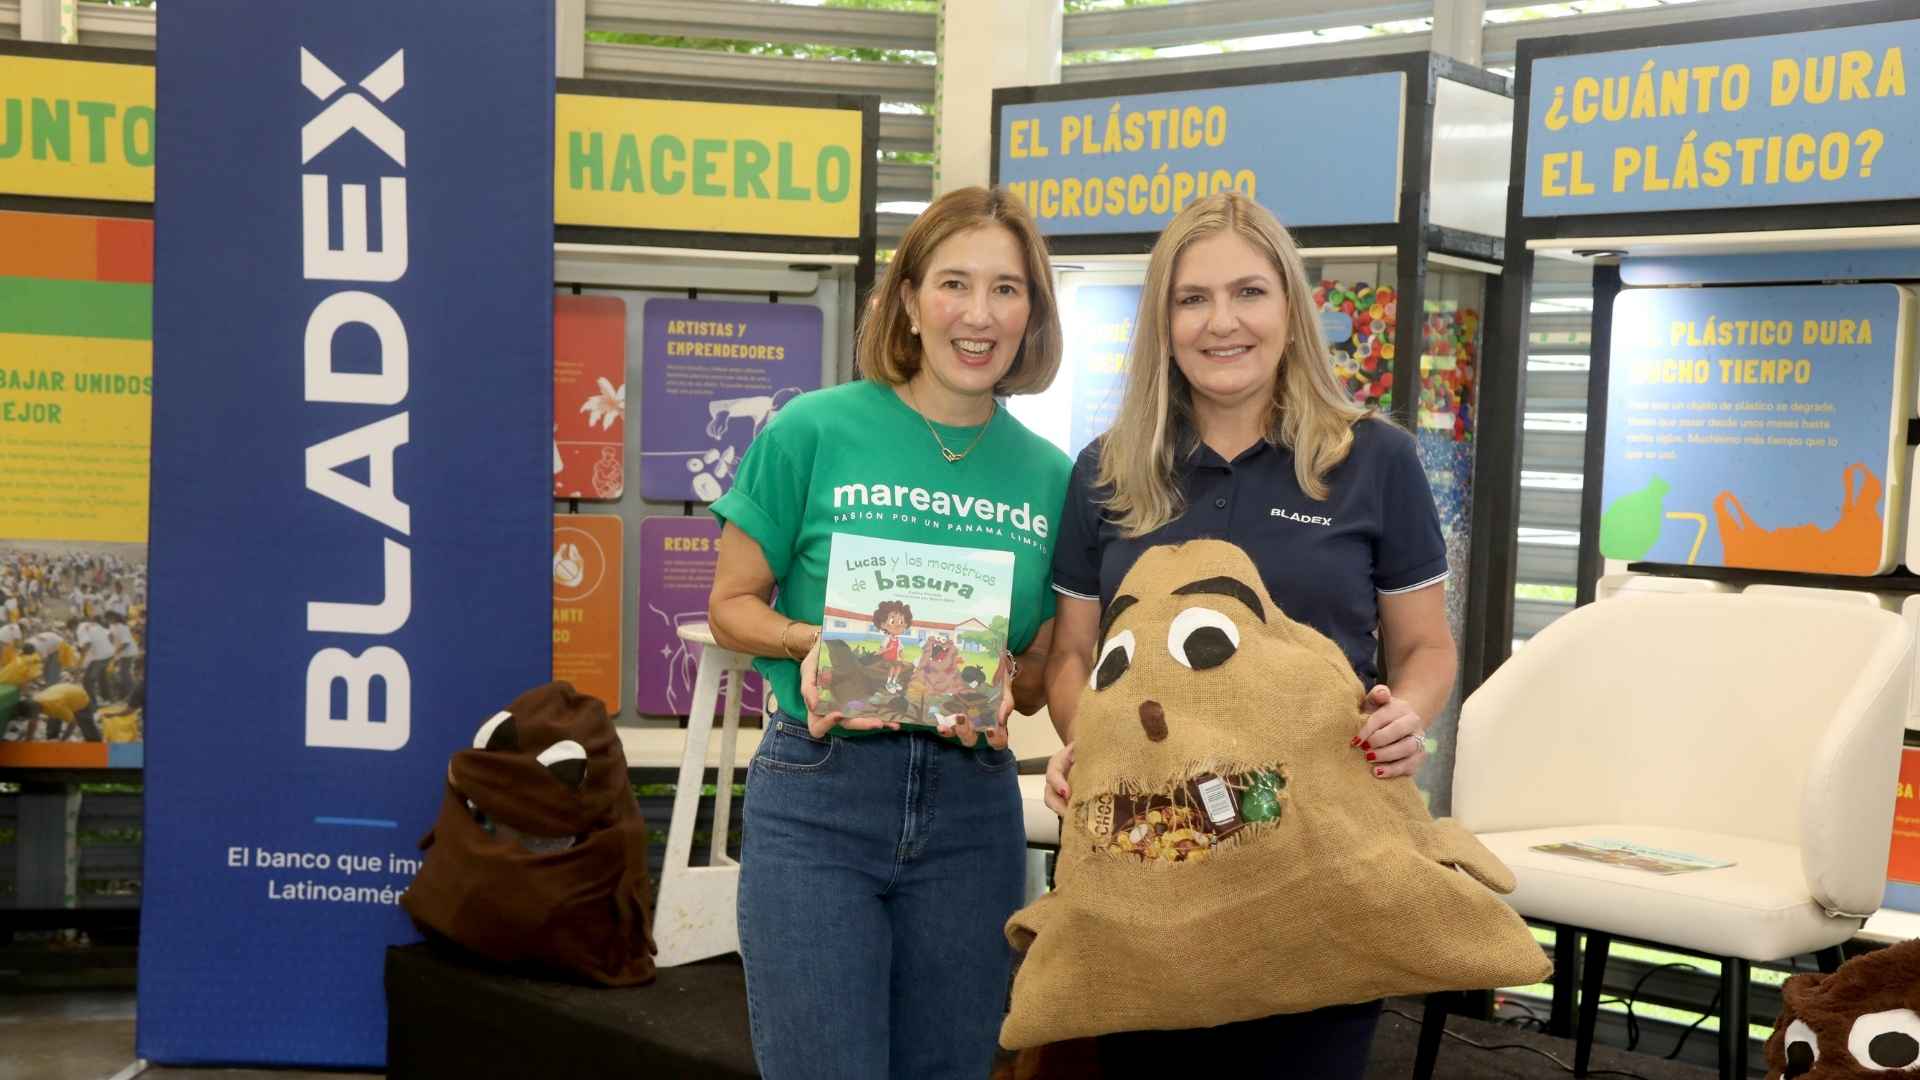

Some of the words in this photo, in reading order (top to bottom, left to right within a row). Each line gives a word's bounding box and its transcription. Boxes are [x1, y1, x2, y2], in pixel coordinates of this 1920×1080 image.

[1544, 59, 1750, 131] ¿CUÁNTO
[1770, 47, 1906, 107] DURA
[1010, 118, 1048, 158] EL
[1060, 102, 1227, 155] PLÁSTICO
[569, 131, 850, 203] HACERLO
[1541, 151, 1595, 197] EL
[1612, 129, 1884, 192] PLÁSTICO?
[667, 321, 733, 337] ARTISTAS
[1671, 315, 1793, 347] PLÁSTICO
[1803, 320, 1872, 345] DURA
[666, 341, 785, 360] EMPRENDEDORES
[1632, 359, 1710, 384] UCHO
[1719, 358, 1812, 384] TIEMPO
[301, 46, 412, 751] BLADEX
[833, 482, 1049, 538] mareaverde
[892, 513, 917, 524] POR
[924, 519, 940, 529] UN
[1270, 507, 1332, 526] BLADEX
[664, 537, 709, 551] REDES
[846, 555, 887, 571] Lucas
[890, 556, 900, 571] y
[904, 552, 922, 567] los
[927, 559, 997, 587] monstruos
[851, 577, 867, 592] de
[874, 570, 974, 600] basura
[227, 846, 249, 867] El
[255, 848, 331, 869] banco
[336, 854, 382, 875] que
[267, 880, 409, 905] Latinoamér
